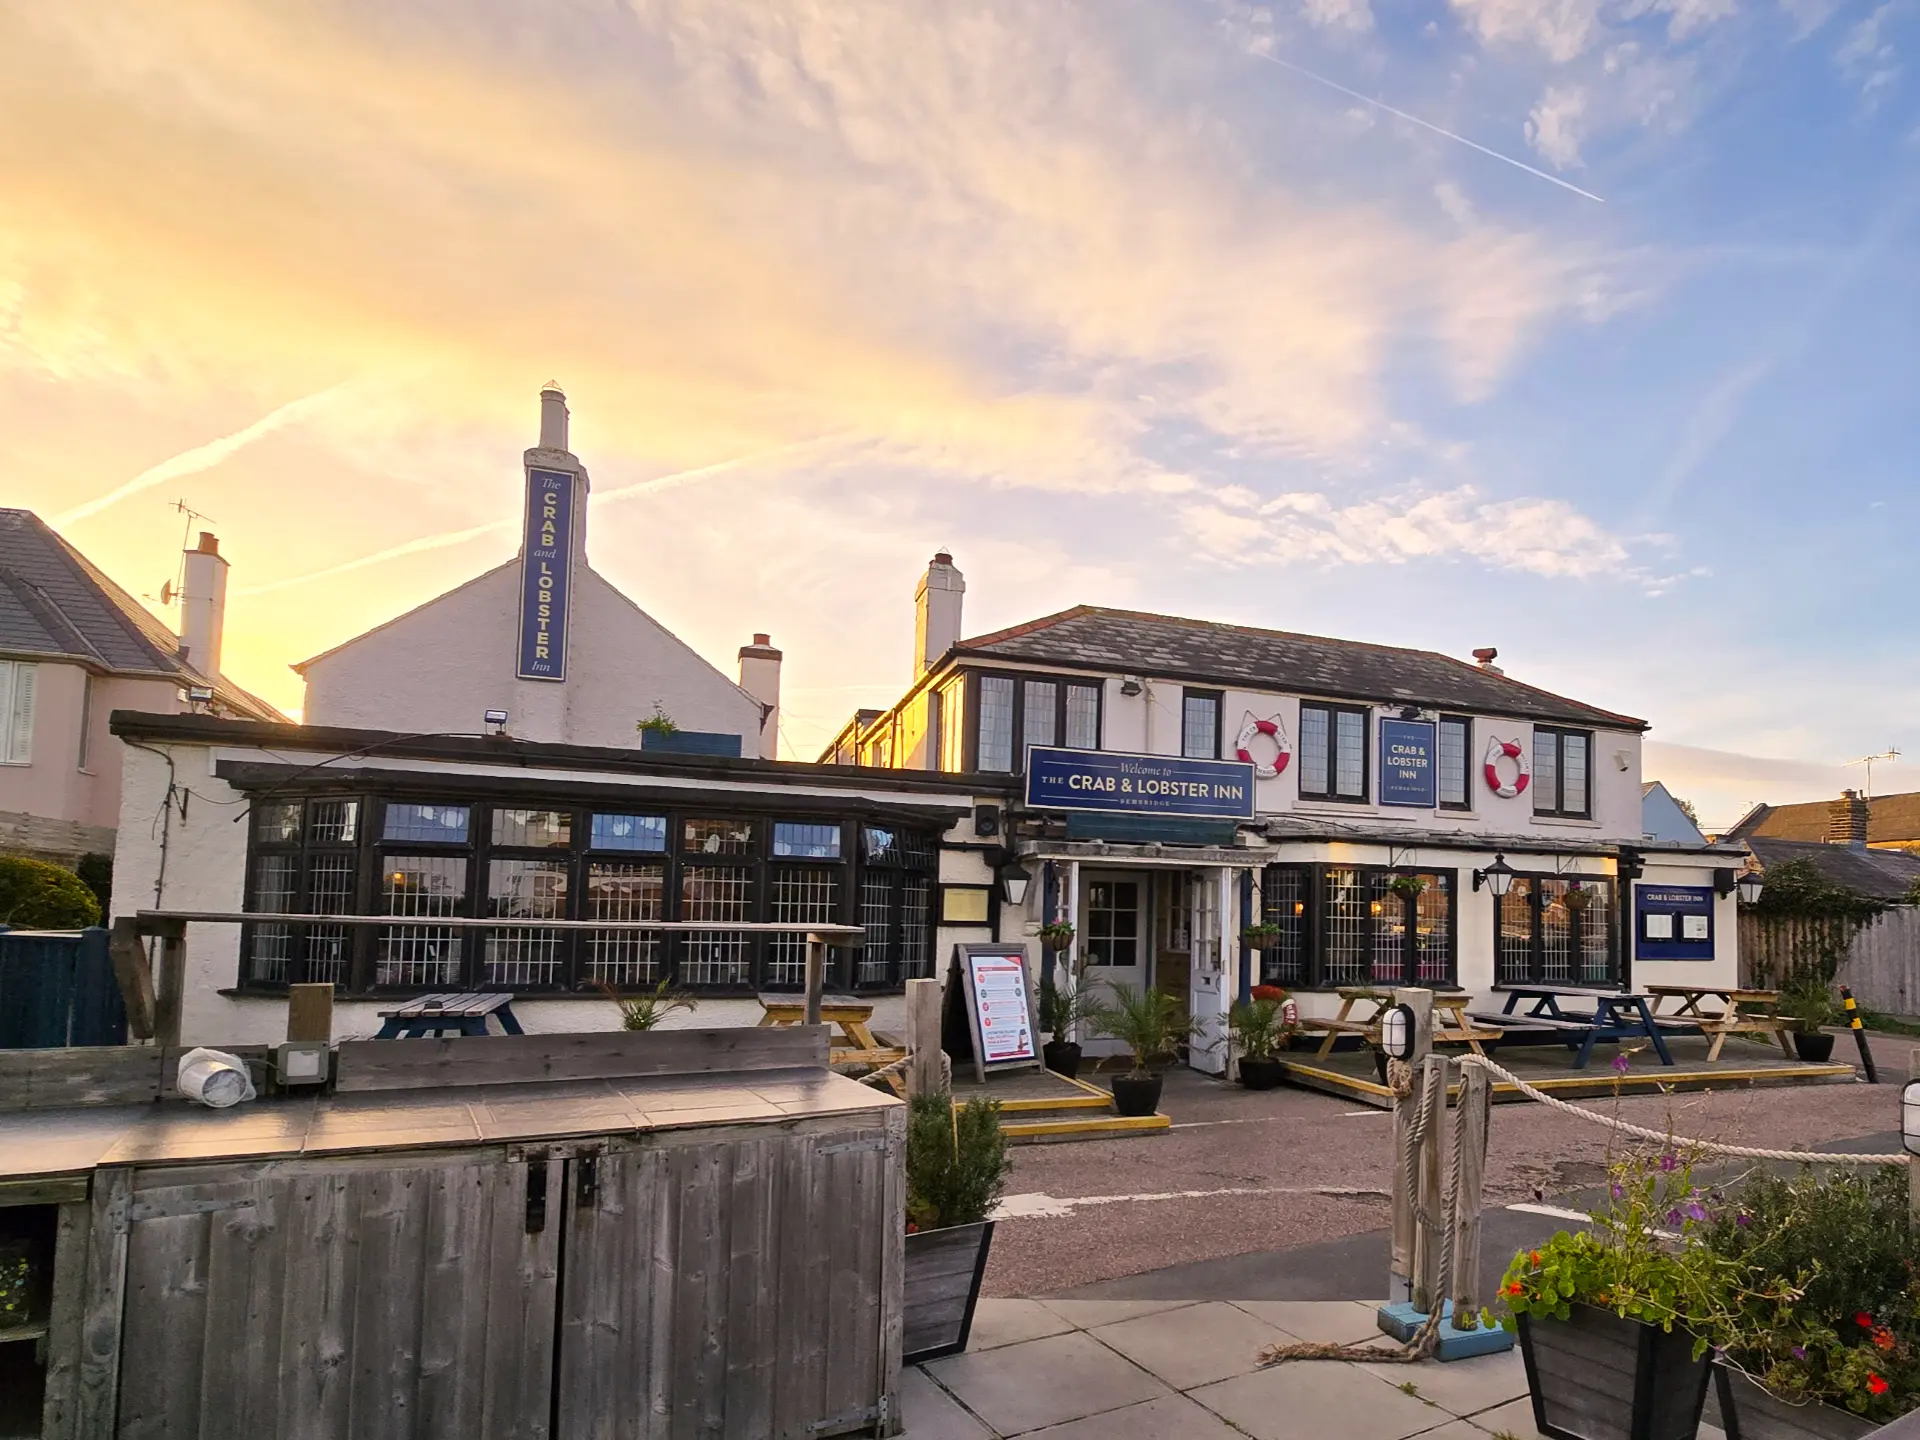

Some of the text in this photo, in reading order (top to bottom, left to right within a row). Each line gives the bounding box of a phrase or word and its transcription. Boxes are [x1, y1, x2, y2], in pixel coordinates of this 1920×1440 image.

[541, 478, 561, 490] The
[541, 492, 557, 547] CRAB
[534, 549, 557, 559] and
[536, 562, 553, 659] LOBSTER
[531, 661, 551, 672] Inn
[1391, 744, 1425, 756] CRAB &
[1387, 756, 1428, 768] LOBSTER
[1121, 762, 1172, 777] Welcome to
[1399, 769, 1417, 779] INN
[1041, 774, 1243, 800] THE CRAB & LOBSTER INN
[1646, 893, 1662, 901] CRAB
[1668, 894, 1692, 902] LOBSTER
